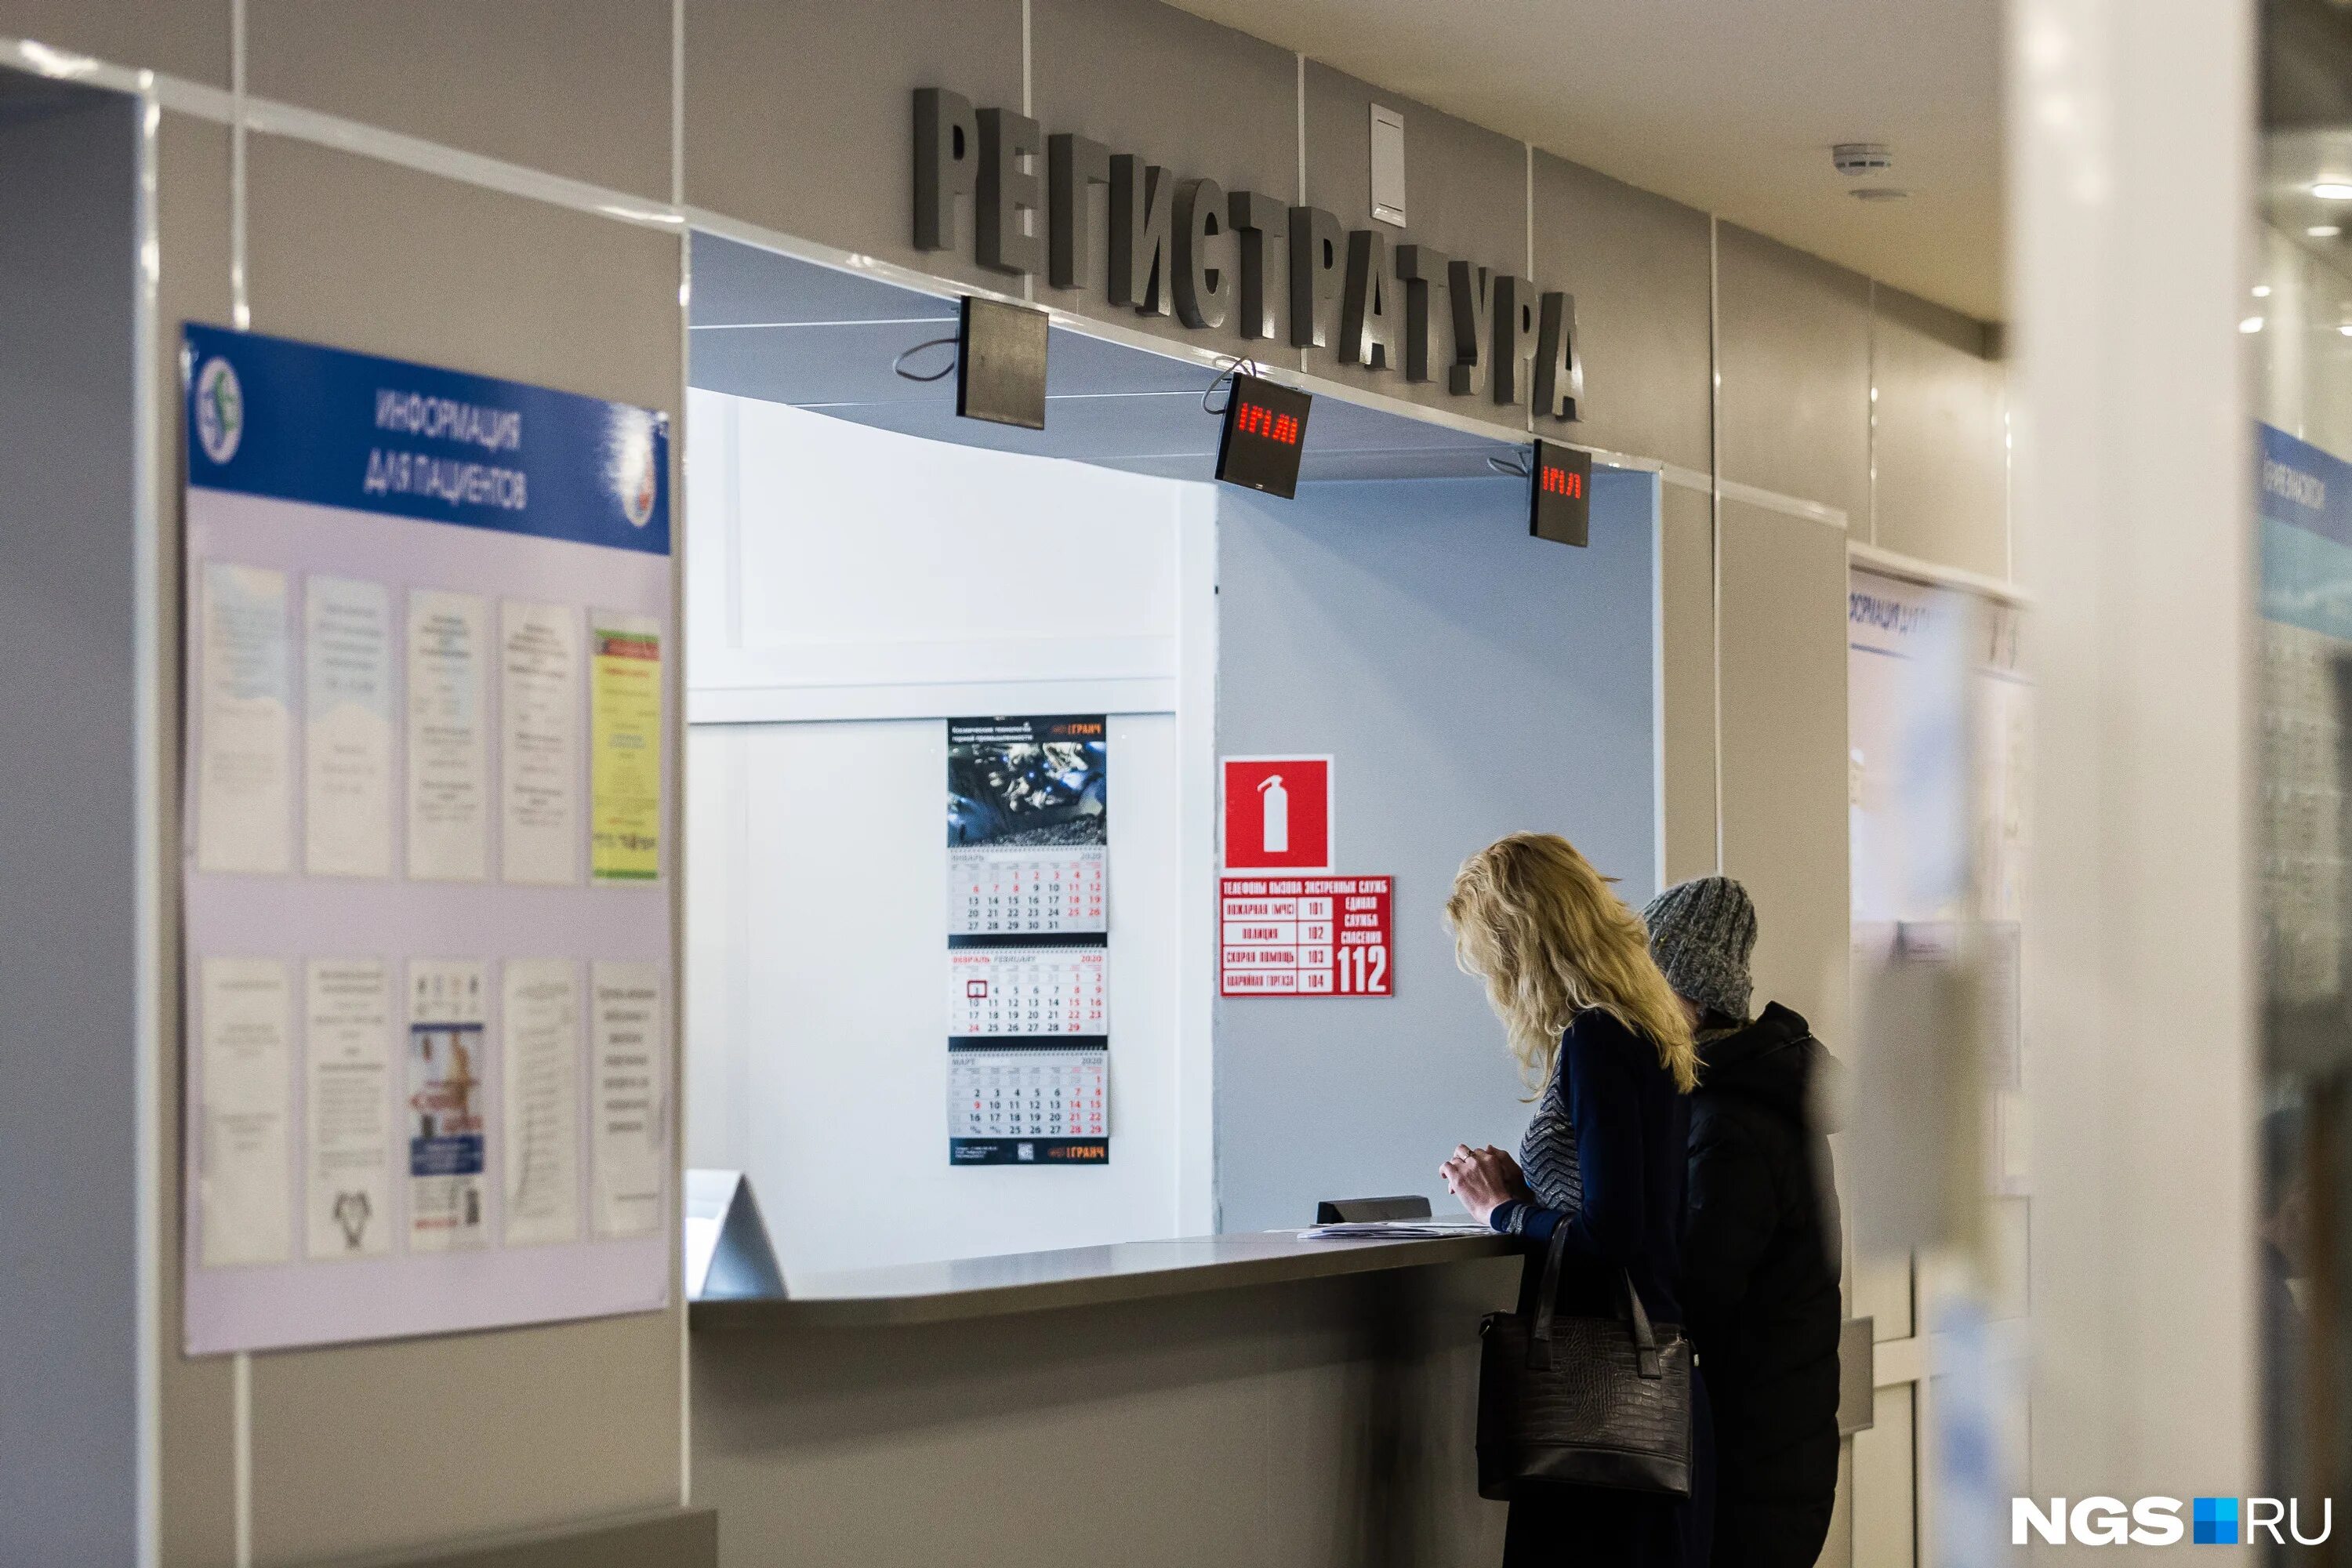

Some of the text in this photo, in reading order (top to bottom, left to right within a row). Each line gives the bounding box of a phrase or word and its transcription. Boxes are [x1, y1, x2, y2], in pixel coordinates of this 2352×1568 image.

[913, 87, 1585, 422] РЕГИСТРАТУРА
[376, 389, 521, 452] ИНФОРМАЦИЯ
[1223, 879, 1388, 895] ТЕЛЕФОНЫ ВЫЗОВА ЭКСТРЕННЫХ СЛУЖБ
[1227, 903, 1268, 915] ПОЖАРНАЯ
[1308, 902, 1323, 915] 101
[1345, 896, 1378, 911] ЕДИНАЯ
[1344, 913, 1379, 928] СЛУЖБА
[1242, 927, 1279, 940] ПОЛИЦИЯ
[1308, 926, 1323, 940] 102
[1080, 954, 1102, 963] 2020
[1226, 951, 1294, 964] СКОРАЯ ПОМОЩЬ
[1308, 949, 1323, 964] 103
[1337, 946, 1387, 993] 112
[1308, 975, 1324, 988] 104
